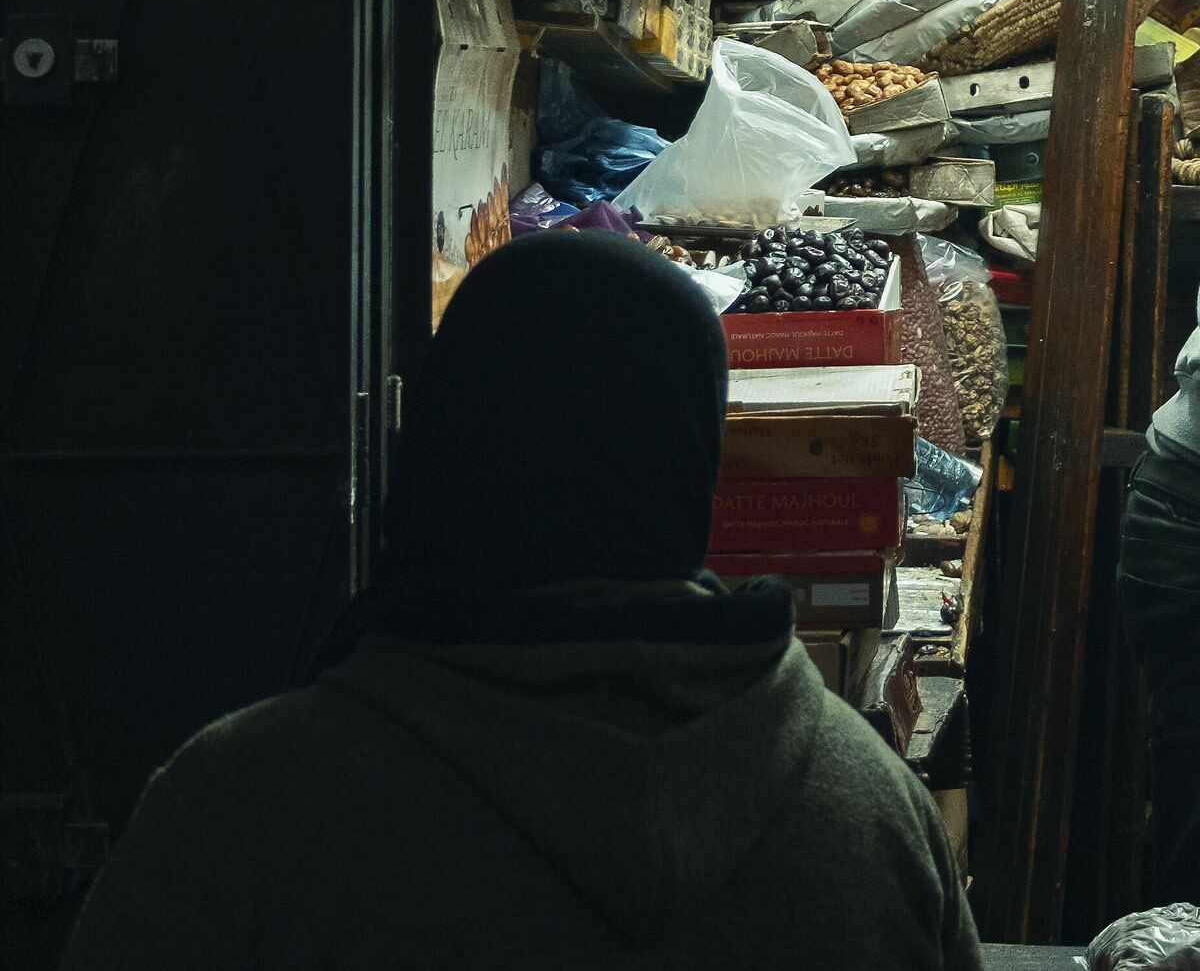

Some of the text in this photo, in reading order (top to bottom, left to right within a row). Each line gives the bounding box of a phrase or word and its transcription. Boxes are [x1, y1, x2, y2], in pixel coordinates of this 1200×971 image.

[728, 345, 854, 362] DATTE MAJHOU
[712, 492, 859, 510] DATTE MAJHOUL
